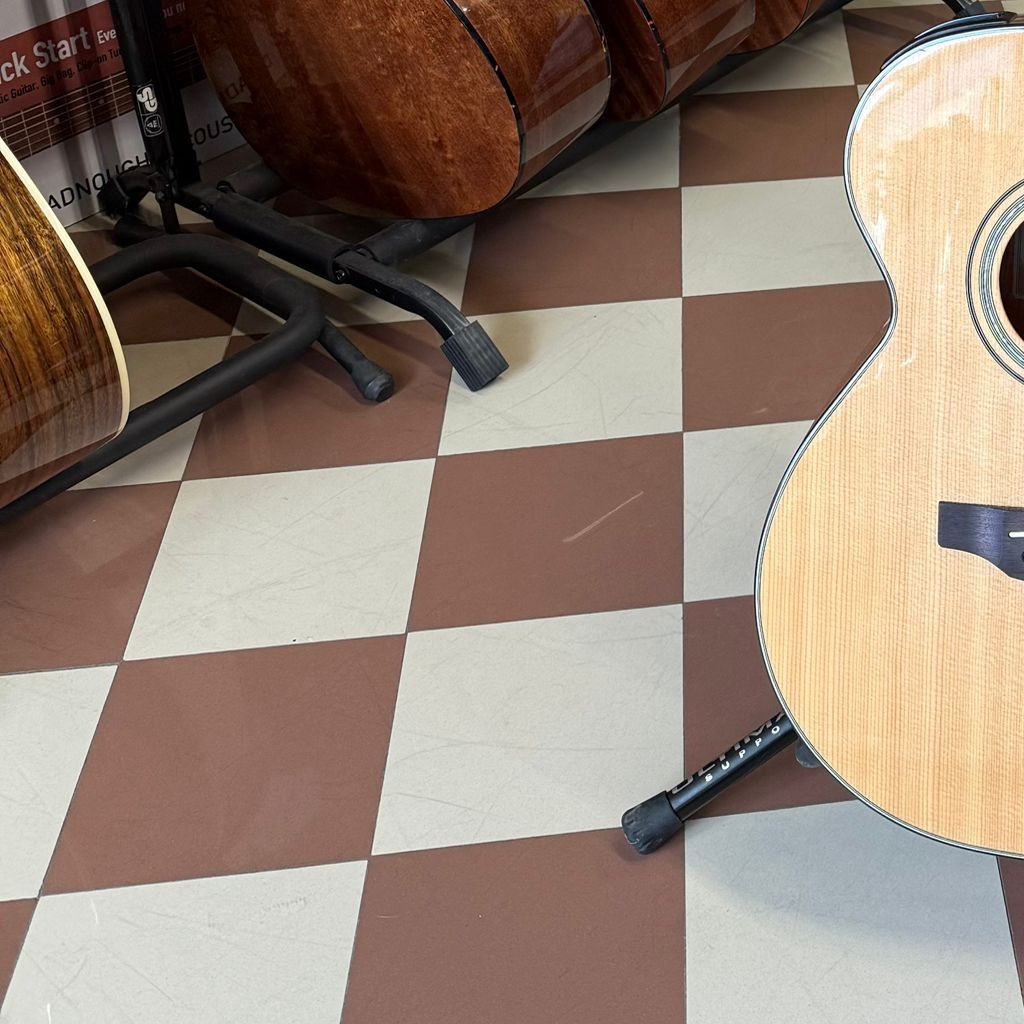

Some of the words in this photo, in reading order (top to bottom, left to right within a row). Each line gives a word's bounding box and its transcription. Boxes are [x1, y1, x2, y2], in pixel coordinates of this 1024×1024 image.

[0, 51, 31, 83] ck
[33, 26, 91, 68] Start
[97, 29, 117, 44] Eve
